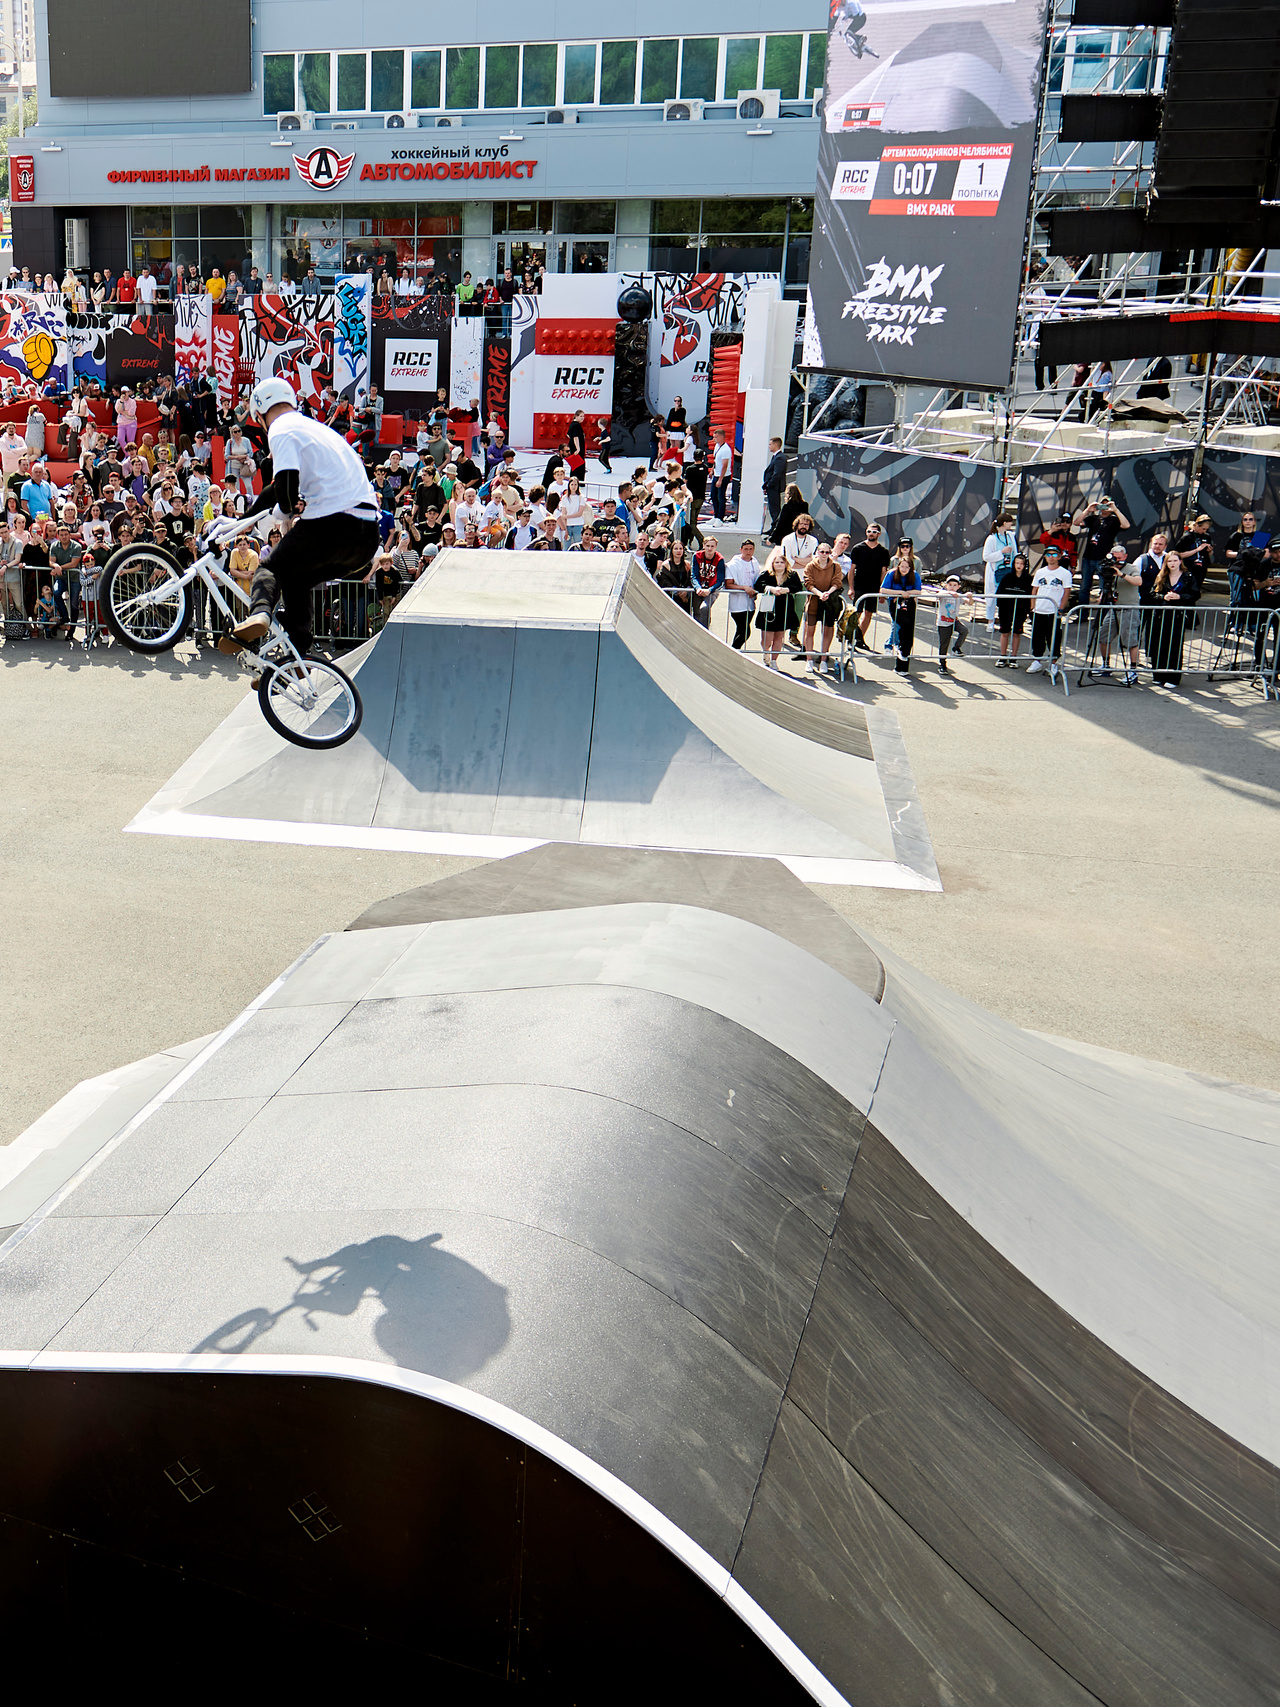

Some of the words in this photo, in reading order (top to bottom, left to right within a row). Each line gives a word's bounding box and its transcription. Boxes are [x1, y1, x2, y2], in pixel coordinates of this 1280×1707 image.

[391, 145, 470, 160] хоккейный
[475, 145, 509, 160] клуб
[881, 148, 907, 158] АРТЕМ
[907, 147, 959, 158] ХОЛОДНЯКОВ
[107, 165, 210, 183] ФИРМЕННЫЙ
[214, 167, 290, 182] МАГАЗИН
[359, 160, 538, 181] АВТОМОБИЛИСТ
[842, 169, 869, 184] RCC
[977, 162, 985, 185] 1
[893, 162, 938, 195] 0:07
[839, 185, 867, 194] EXTREME
[958, 190, 999, 199] ПОПЫТКА
[906, 203, 928, 216] BMX
[928, 203, 956, 216] PARK
[852, 255, 945, 303] BMX
[841, 301, 947, 325] FREESTYLE
[866, 322, 918, 346] PARK
[121, 358, 160, 369] EXTREME
[393, 351, 432, 366] RCC
[390, 368, 429, 378] EXTREME
[554, 367, 605, 386] RCC
[551, 388, 601, 400] EXTREME
